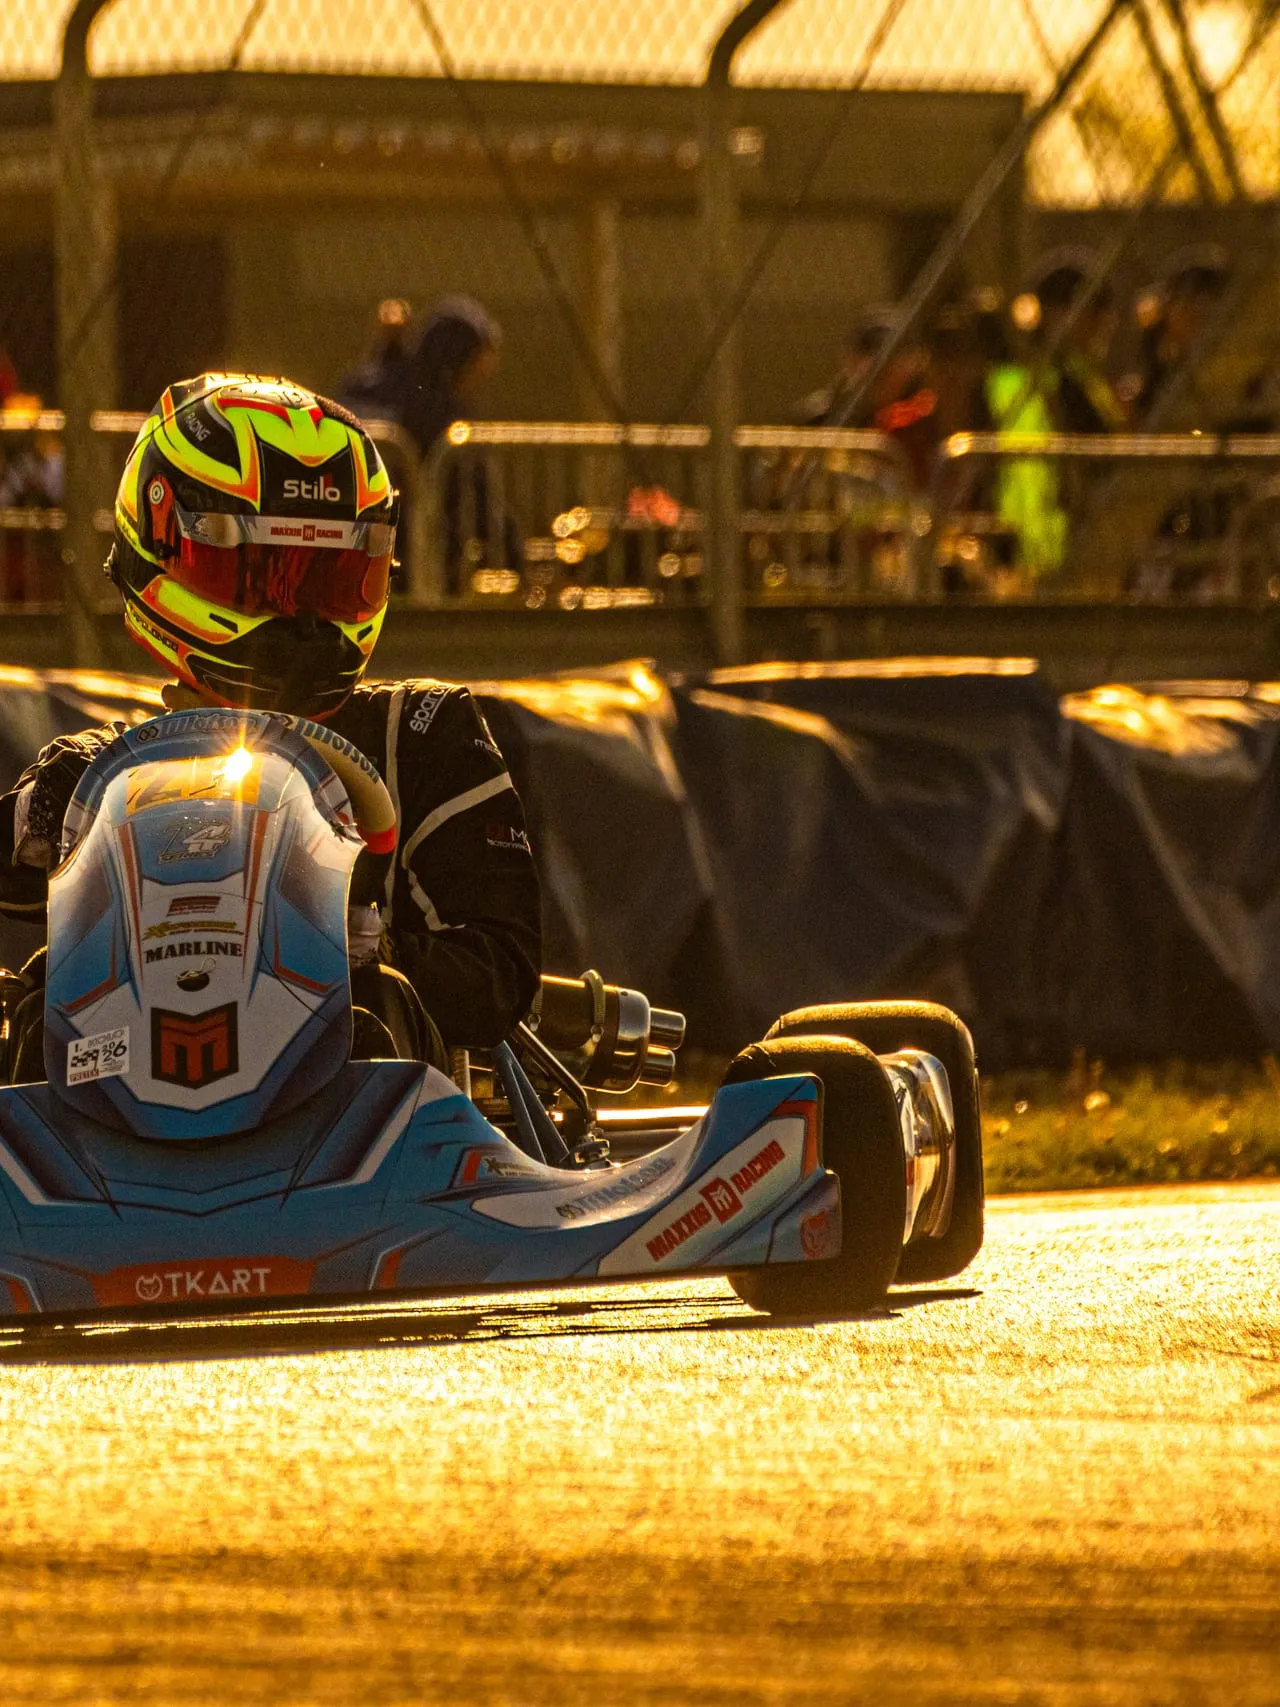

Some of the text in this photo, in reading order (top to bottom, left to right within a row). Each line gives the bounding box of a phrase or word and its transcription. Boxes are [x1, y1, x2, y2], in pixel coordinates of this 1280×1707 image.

[282, 474, 341, 502] Stilo
[144, 941, 243, 964] MARLINE
[646, 1199, 712, 1262] MAXXIS
[729, 1139, 785, 1196] RACING
[164, 1267, 272, 1297] TKART
